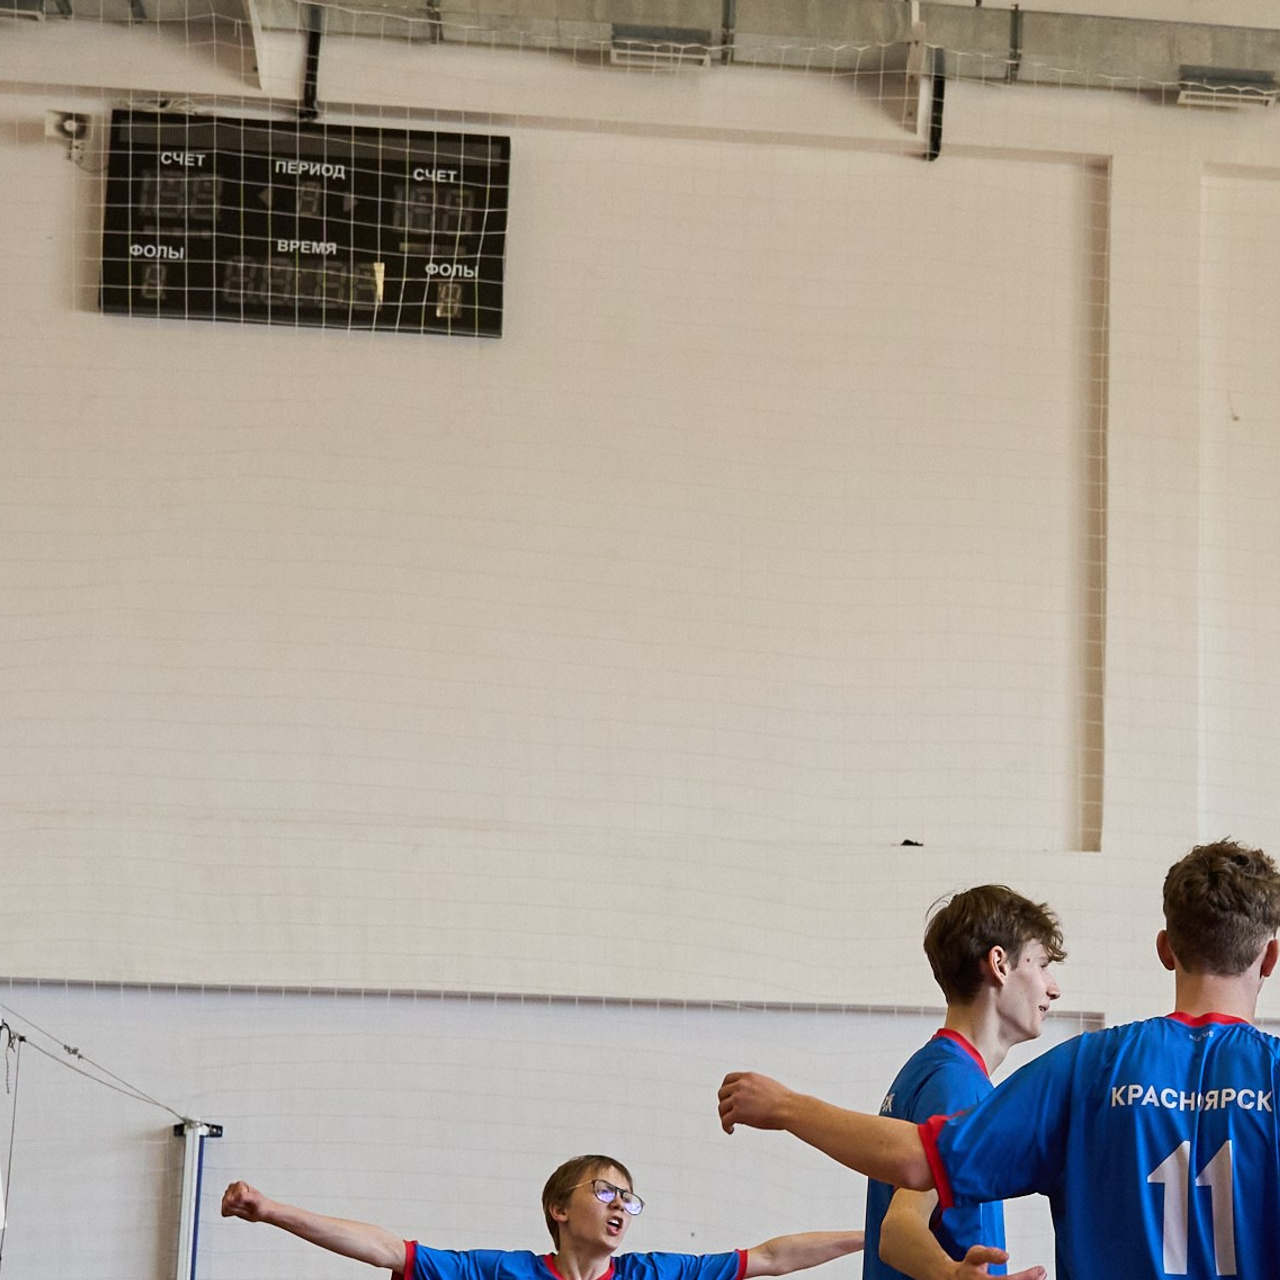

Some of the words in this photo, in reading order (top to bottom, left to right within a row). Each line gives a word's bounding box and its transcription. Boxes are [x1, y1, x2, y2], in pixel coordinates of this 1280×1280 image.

[160, 151, 206, 167] СЧЕТ
[275, 159, 346, 180] ПЕРИОД
[413, 168, 458, 183] СЧЕТ
[129, 243, 184, 260] ФОЛЫ
[277, 239, 337, 256] ВРЕМЯ
[425, 263, 478, 278] ФОЛЫ
[1147, 1140, 1237, 1276] 11
